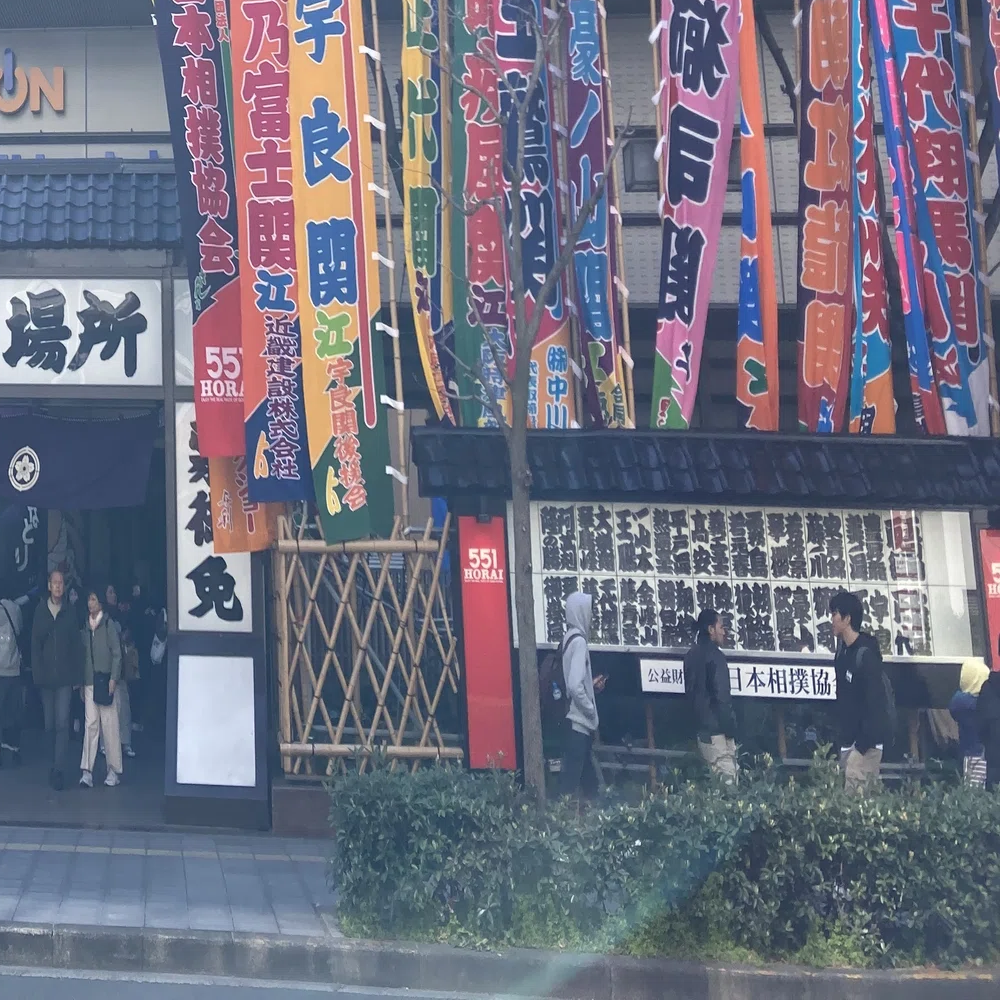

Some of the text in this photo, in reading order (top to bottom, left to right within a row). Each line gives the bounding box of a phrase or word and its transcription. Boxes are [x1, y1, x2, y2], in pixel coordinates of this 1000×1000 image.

[200, 380, 244, 397] HOR
[264, 313, 301, 481] 近畿建設株式会社
[325, 357, 368, 511] 宇良関後援会
[469, 548, 498, 569] 551
[464, 568, 504, 580] HORAI
[729, 666, 837, 696] 日本相撲協
